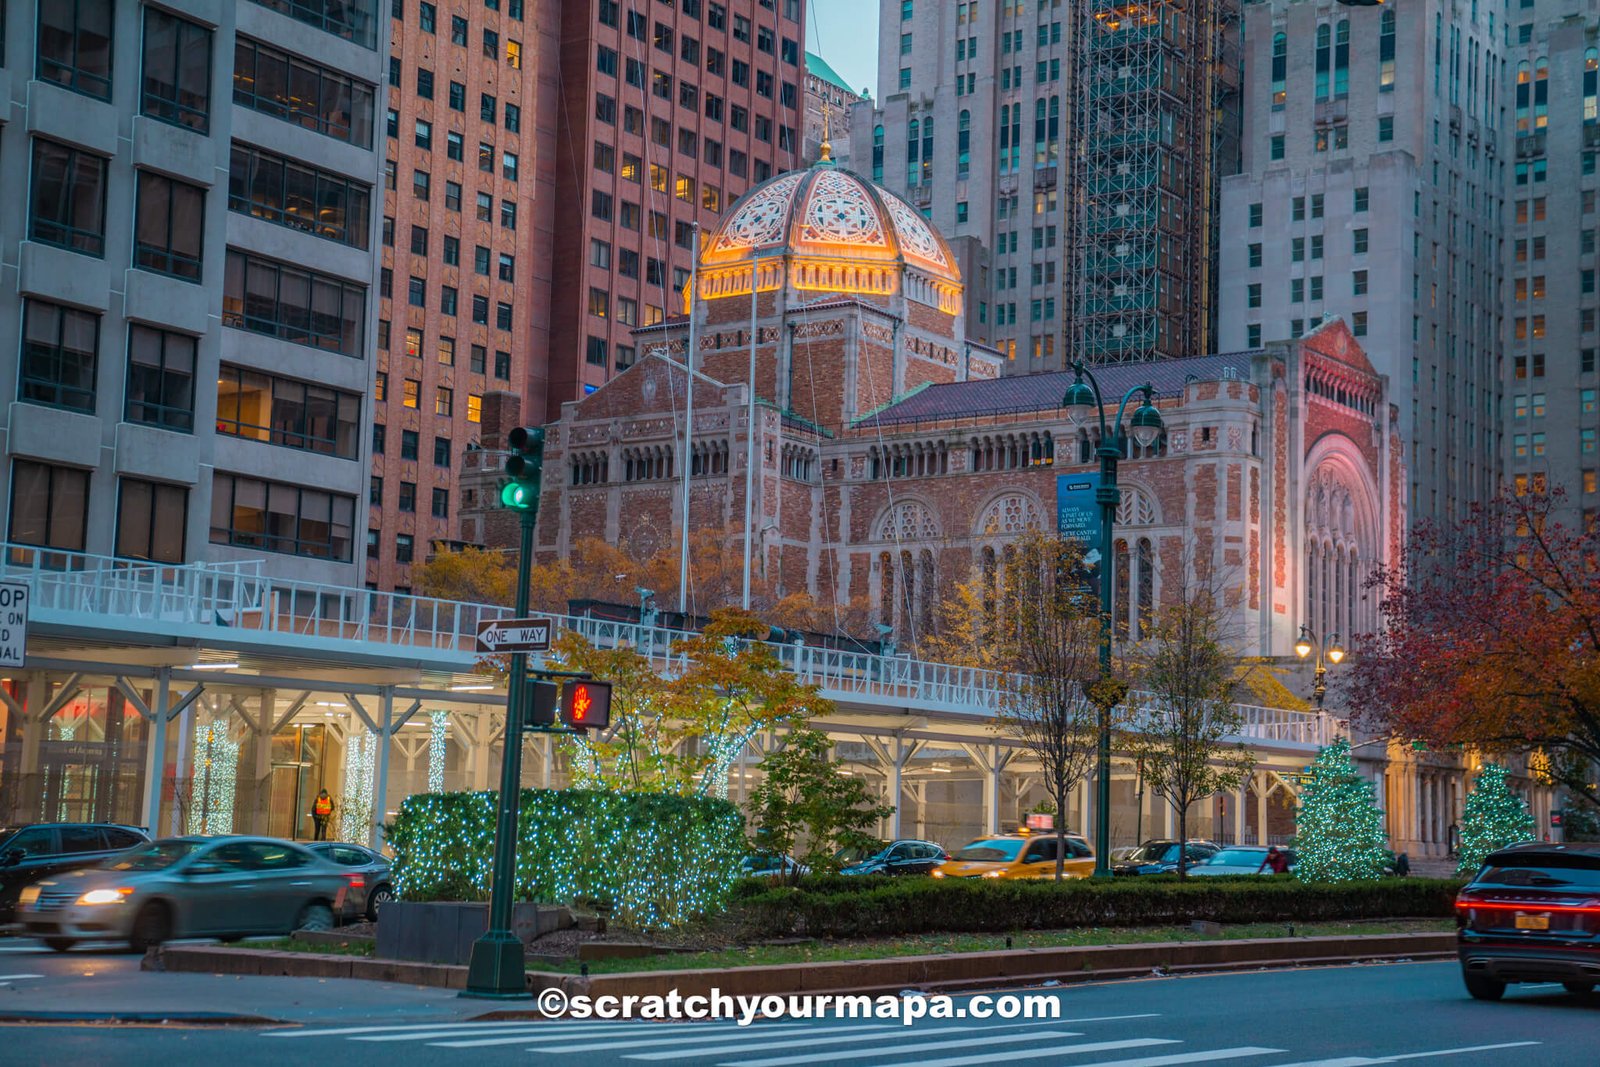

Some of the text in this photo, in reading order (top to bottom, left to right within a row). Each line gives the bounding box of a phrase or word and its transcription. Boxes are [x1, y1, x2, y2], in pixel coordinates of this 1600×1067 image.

[0, 588, 25, 608] OP
[8, 612, 24, 625] ON
[0, 628, 10, 641] D
[486, 628, 544, 643] ONE WAY
[0, 645, 20, 660] AL
